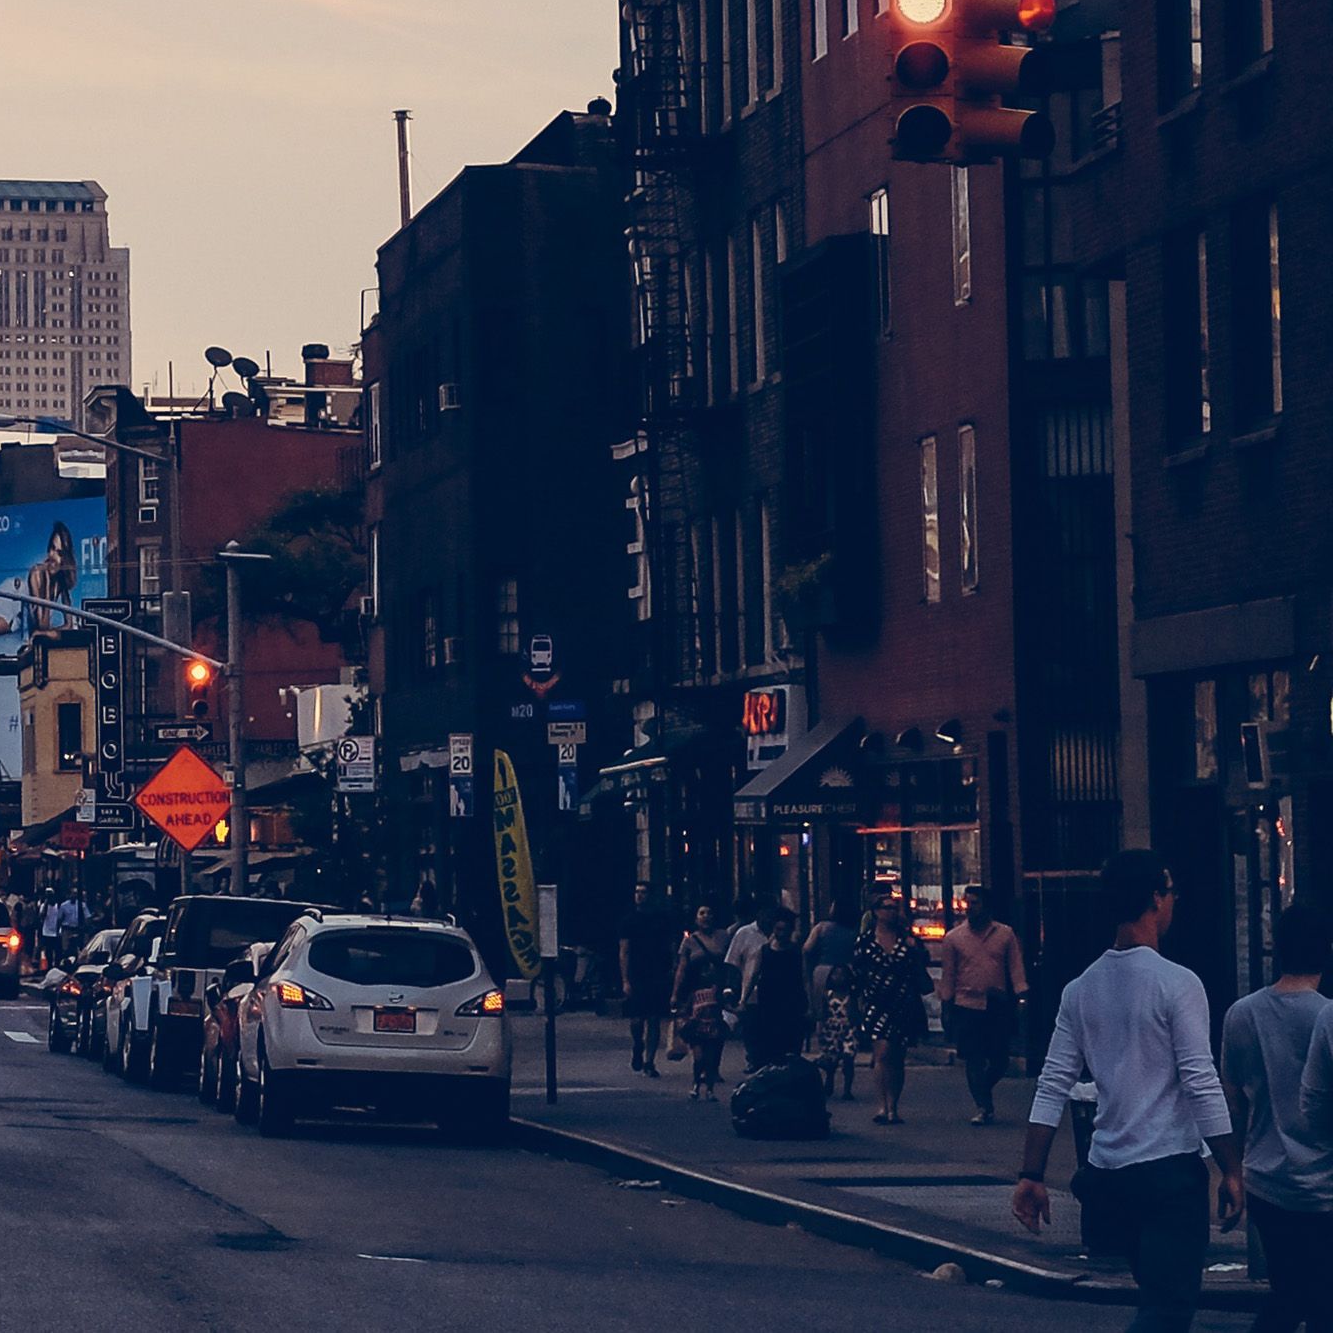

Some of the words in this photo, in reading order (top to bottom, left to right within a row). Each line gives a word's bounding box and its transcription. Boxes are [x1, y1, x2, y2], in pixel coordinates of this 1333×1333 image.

[511, 704, 534, 718] M20
[162, 729, 179, 738] ONE
[187, 729, 204, 738] WAY
[561, 744, 575, 760] 20
[453, 756, 470, 771] 20
[140, 790, 230, 807] CONSTRUCTION
[166, 812, 212, 827] AHEAD
